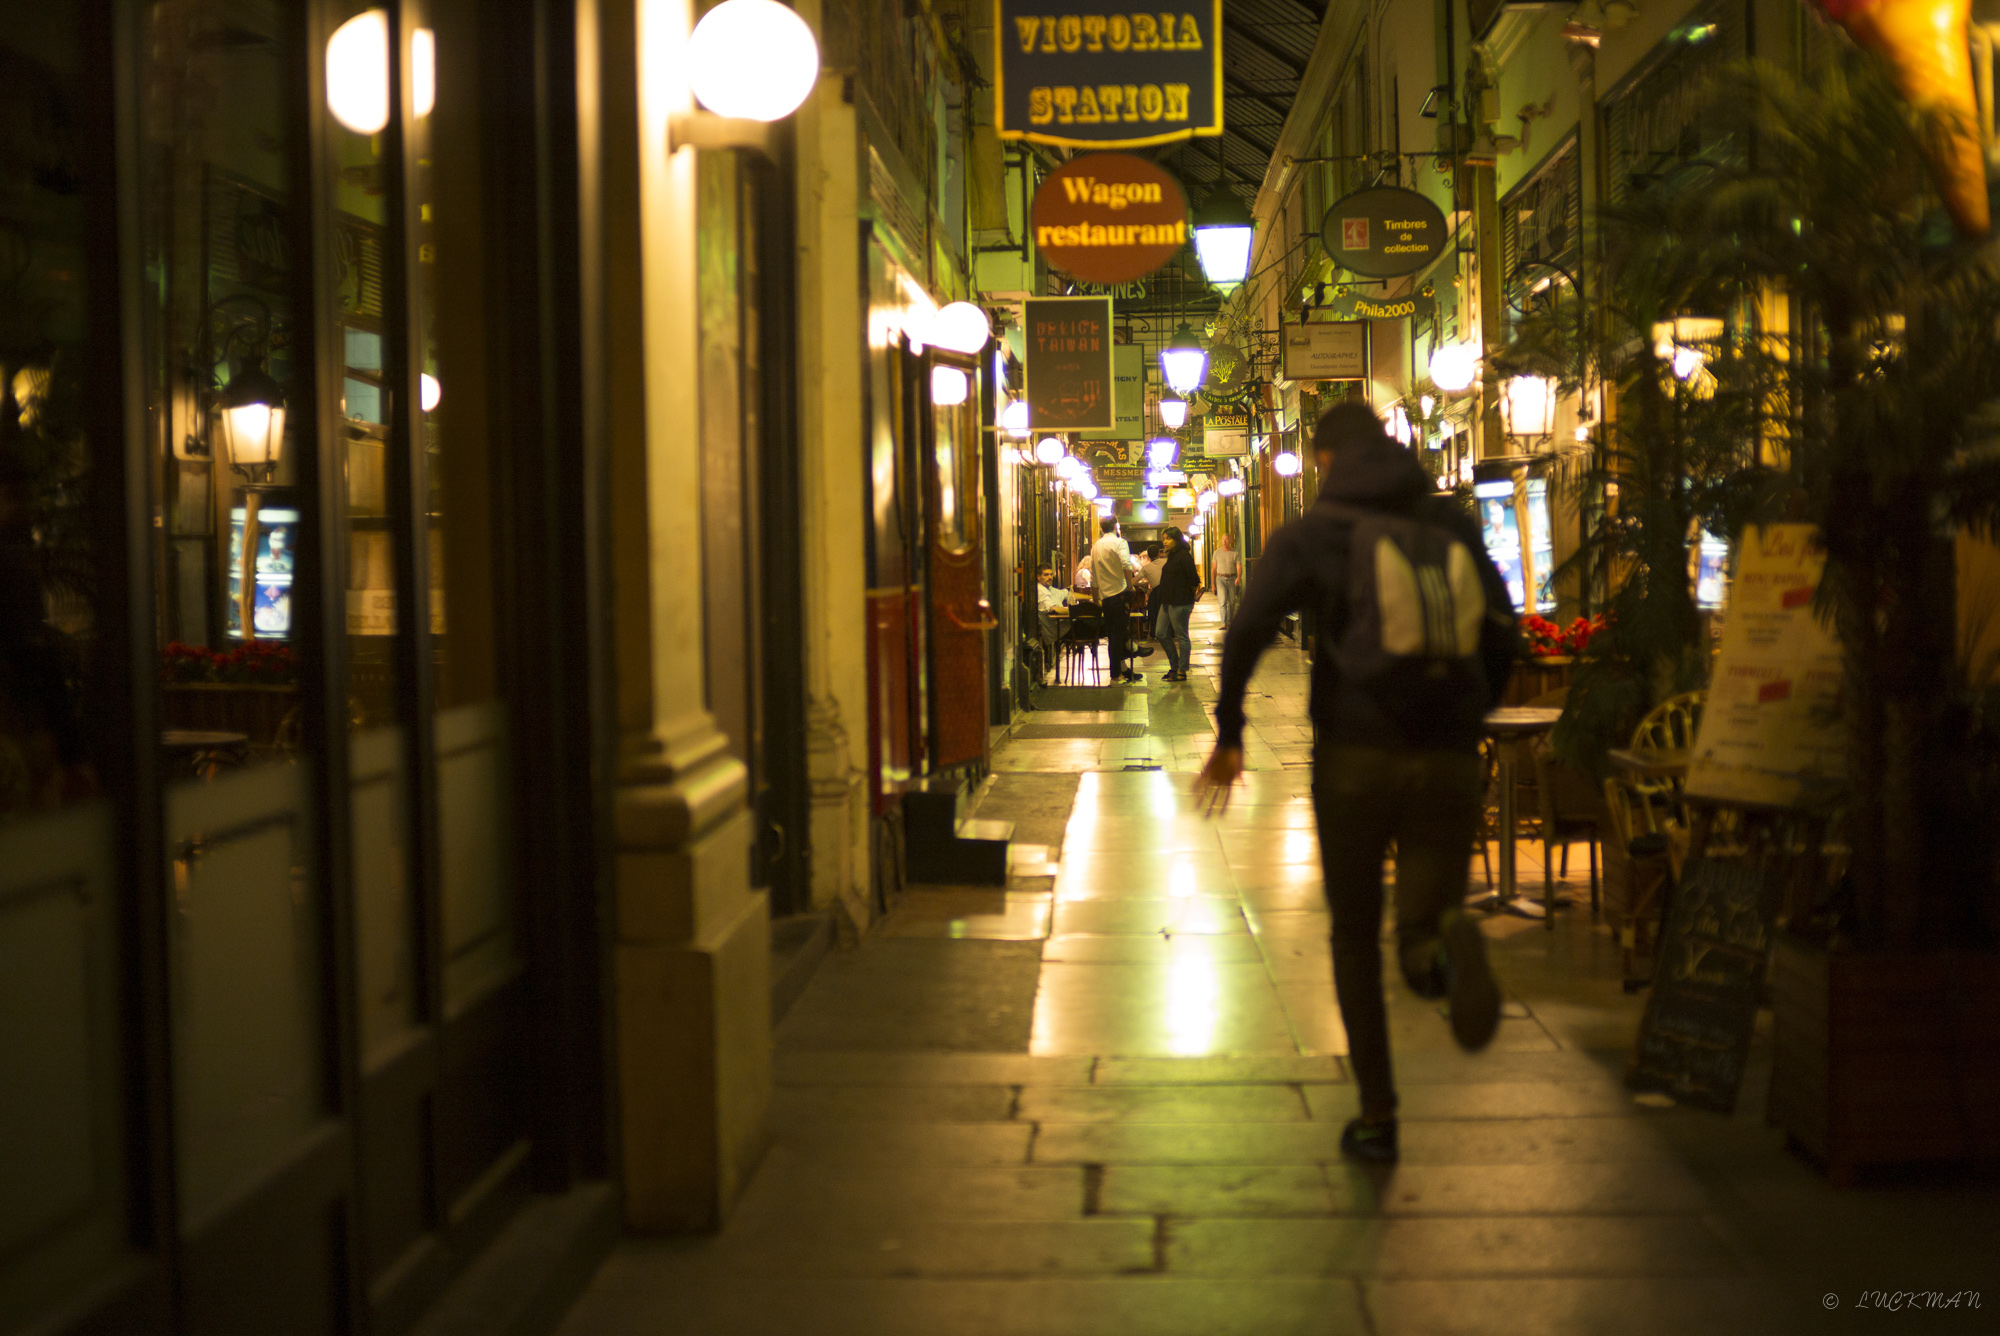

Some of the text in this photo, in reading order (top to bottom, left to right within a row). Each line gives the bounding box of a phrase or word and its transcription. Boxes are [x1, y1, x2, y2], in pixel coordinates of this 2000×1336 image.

[1015, 13, 1203, 53] VICTORIA
[1029, 83, 1190, 124] STATION
[1062, 176, 1162, 210] Wagon
[1037, 219, 1186, 246] restaurant
[1384, 219, 1427, 230] Timbres
[1400, 232, 1412, 241] de
[1384, 243, 1429, 253] collection
[1354, 301, 1415, 318] Phila2000
[1036, 320, 1099, 337] DELICE
[1037, 337, 1099, 352] TAIWAN
[1311, 352, 1358, 360] AUTOGRAPHES
[1204, 416, 1248, 425] LA POSTALE
